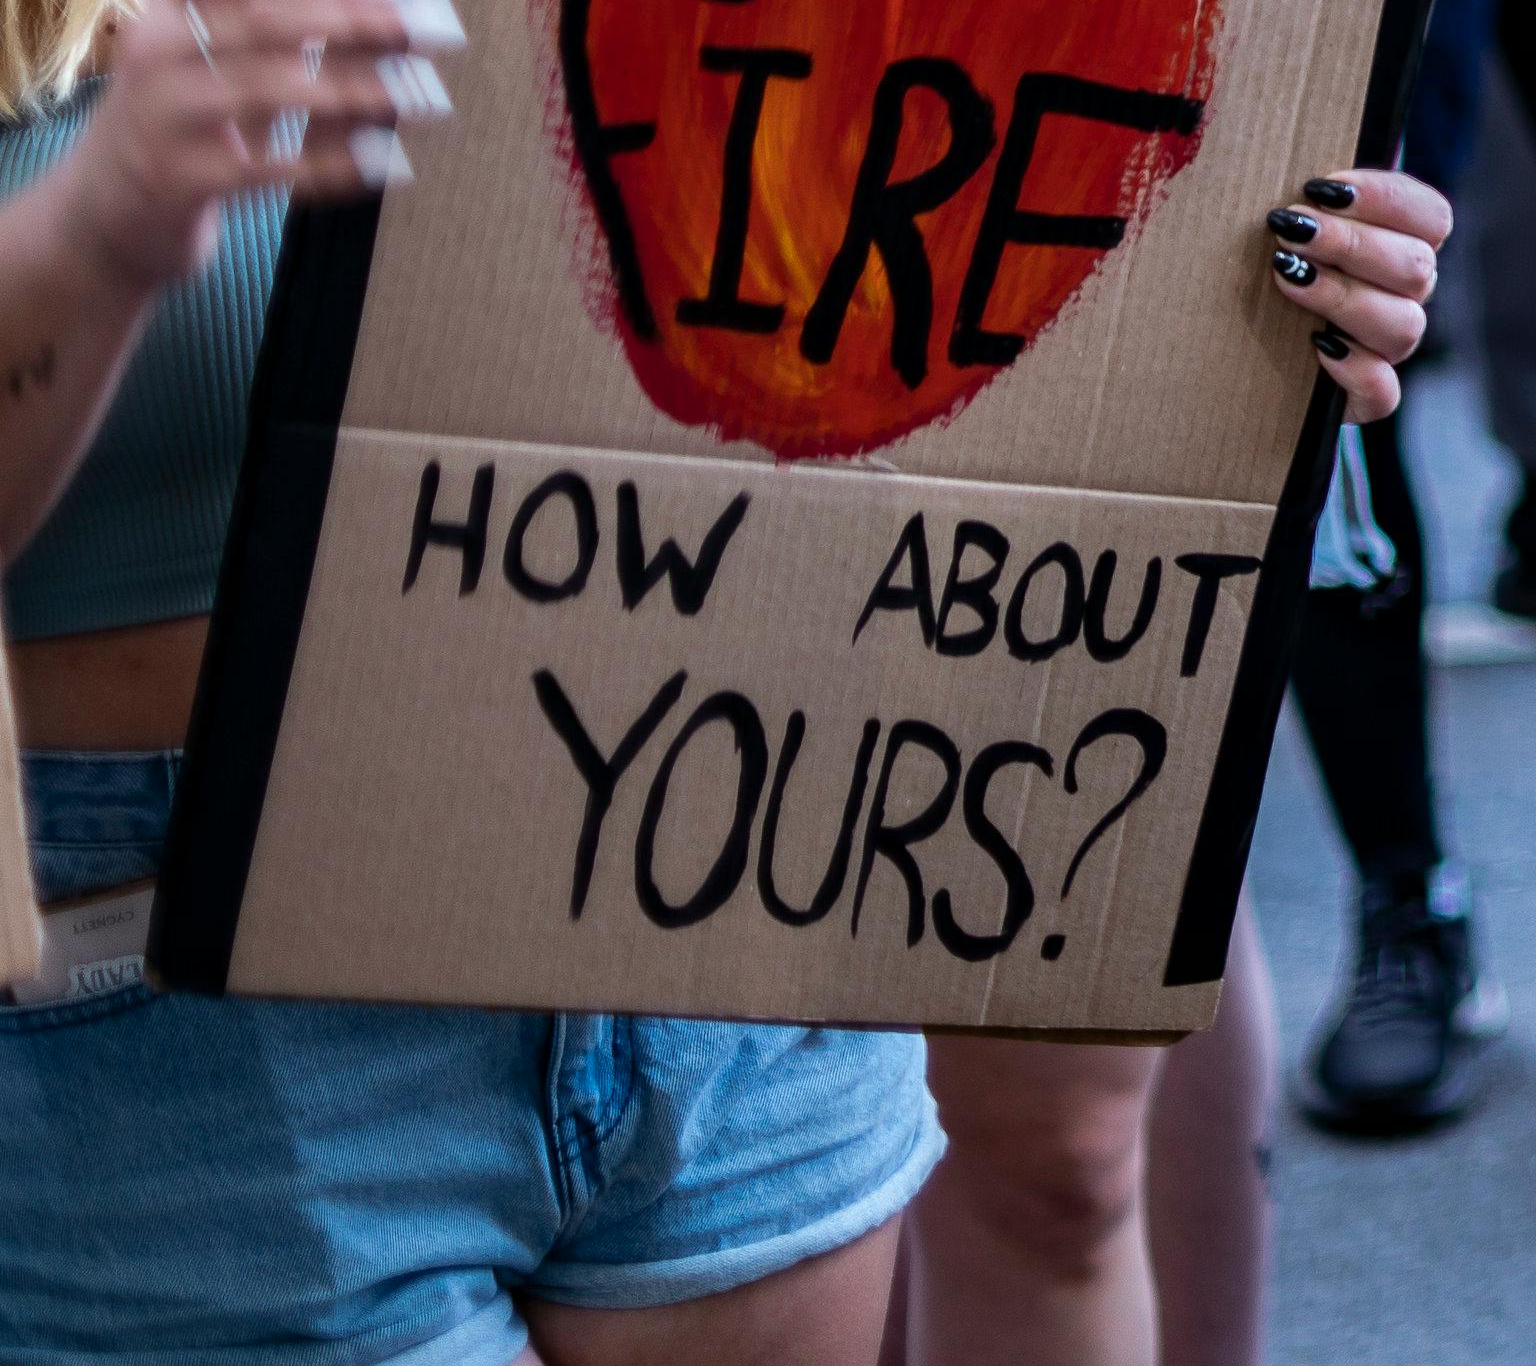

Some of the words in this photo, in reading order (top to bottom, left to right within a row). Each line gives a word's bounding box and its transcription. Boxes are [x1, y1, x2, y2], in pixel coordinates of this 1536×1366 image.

[403, 462, 753, 615] HOW
[851, 510, 1263, 677] ABOUT
[532, 669, 1168, 963] YOURS?
